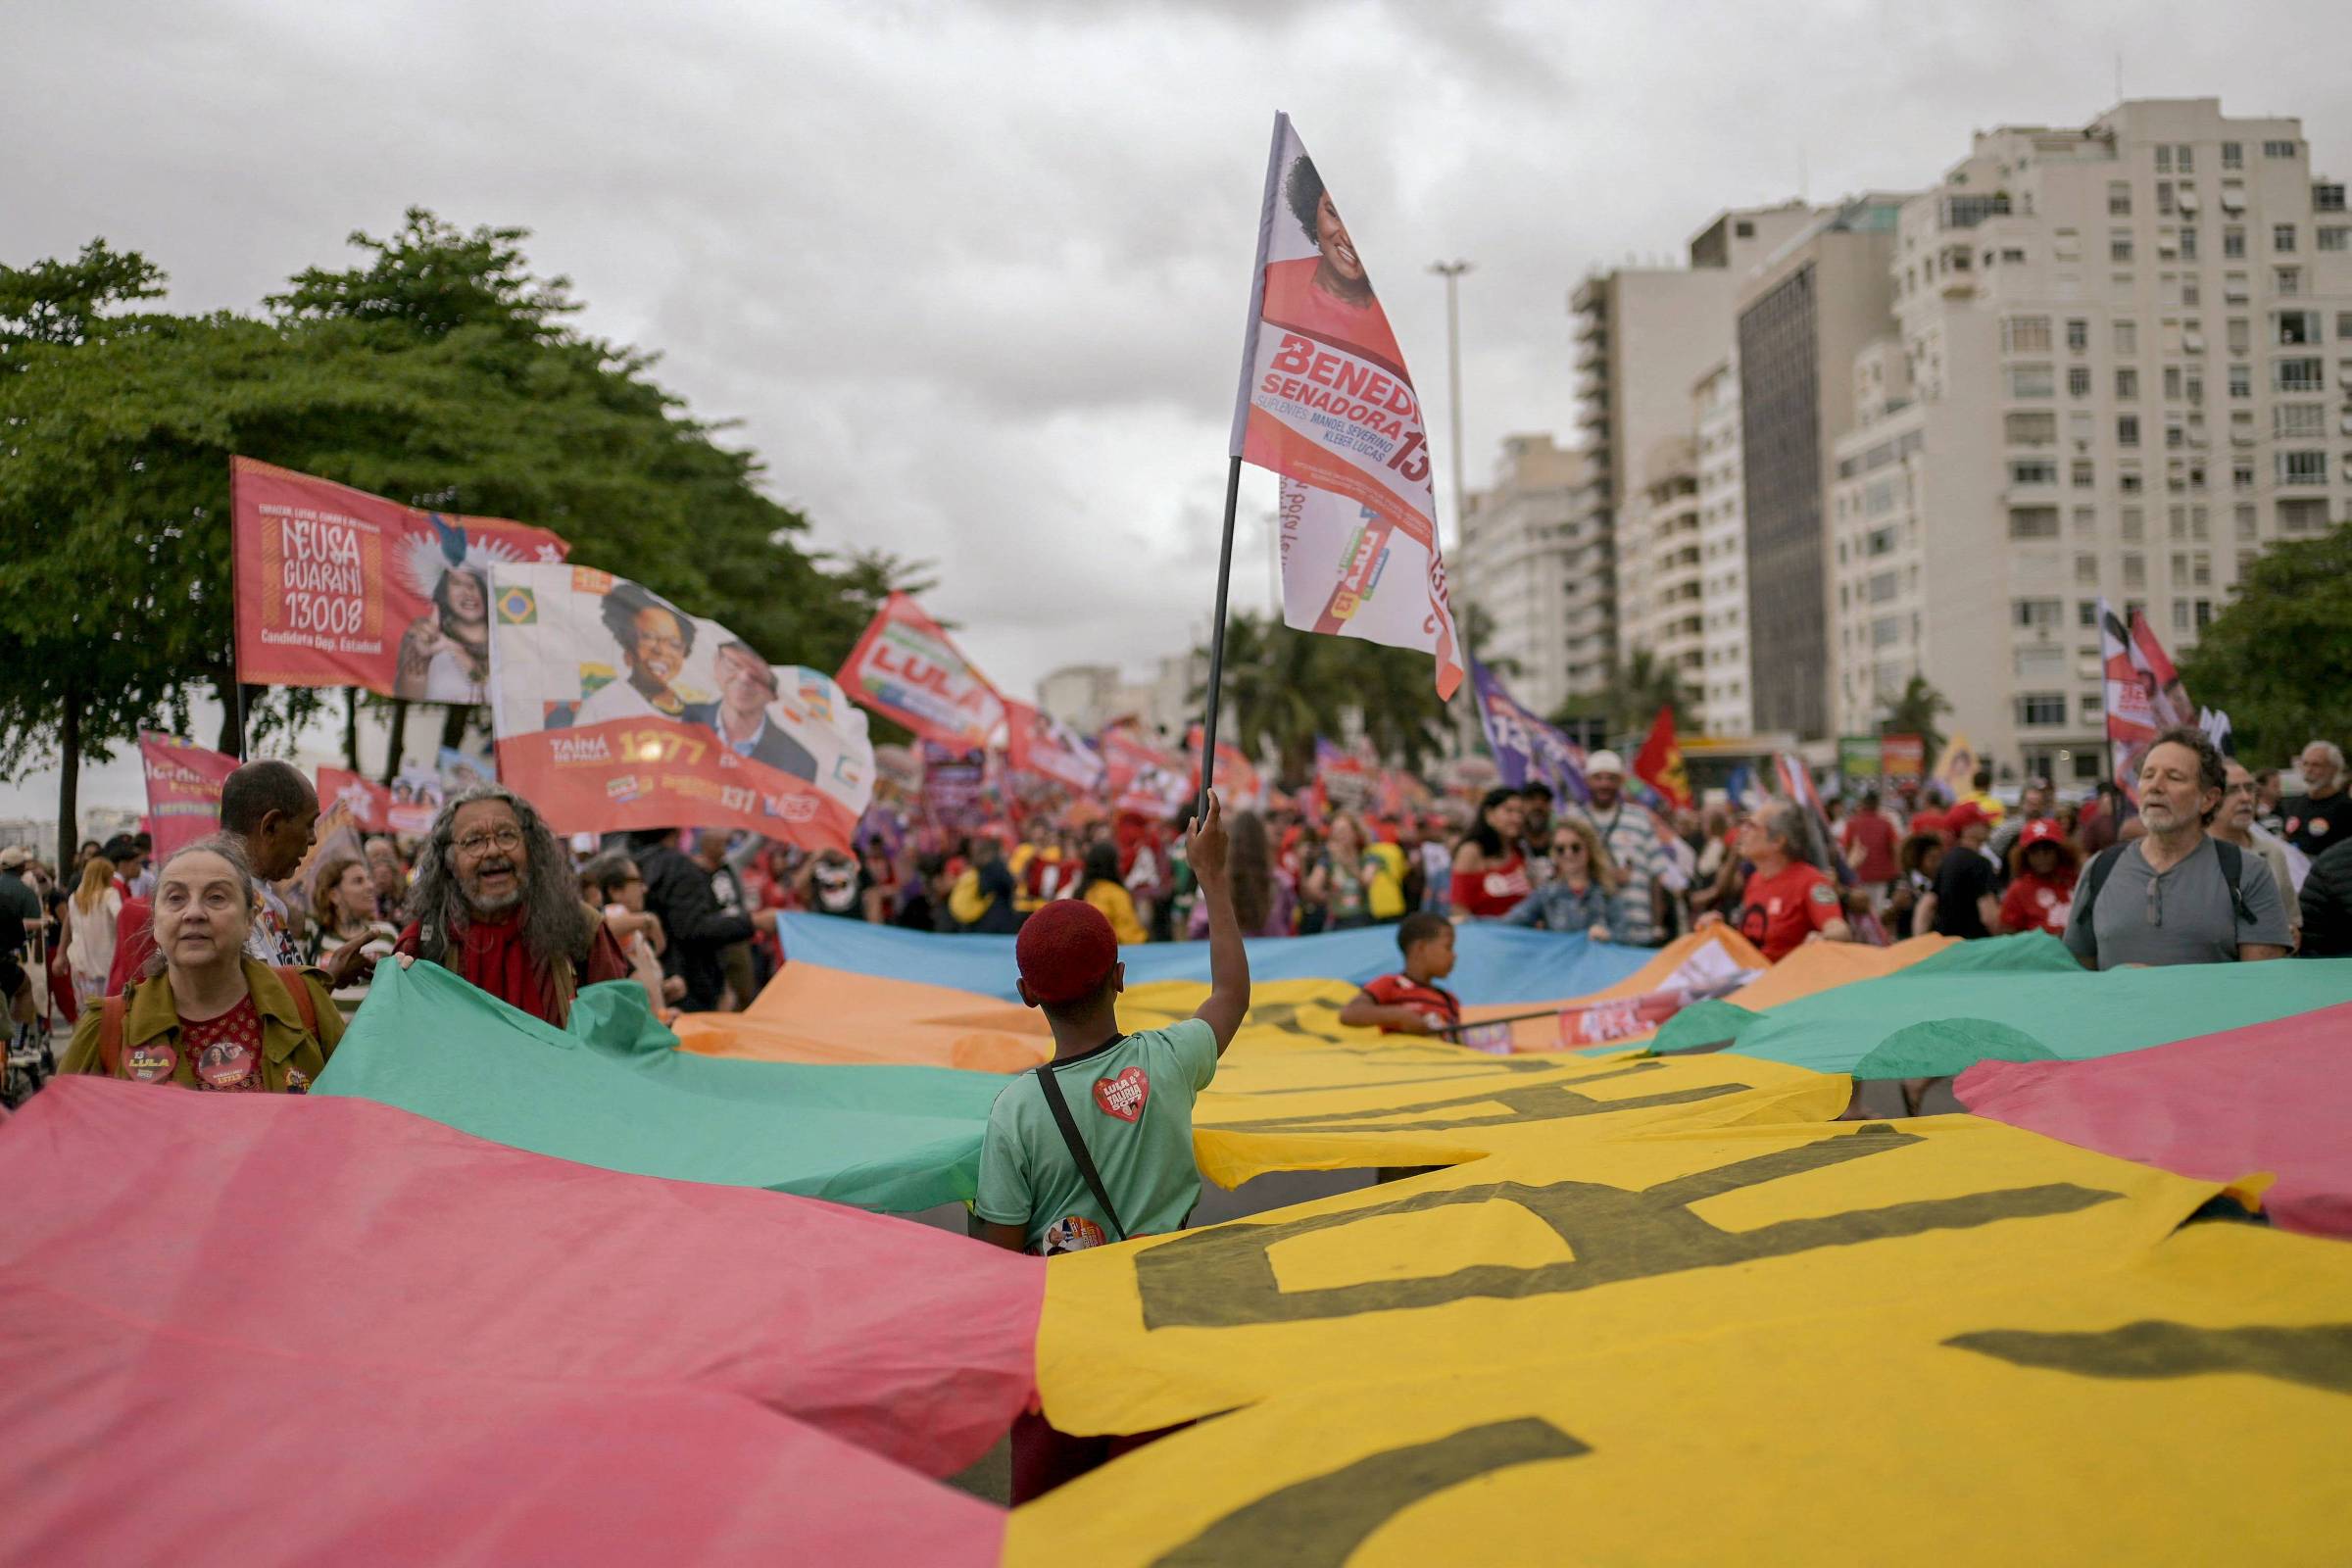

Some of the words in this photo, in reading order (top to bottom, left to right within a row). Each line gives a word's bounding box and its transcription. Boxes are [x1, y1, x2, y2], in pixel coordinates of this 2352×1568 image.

[1260, 373, 1402, 441] SENADORA
[1309, 412, 1346, 433] MANOEL
[1348, 423, 1394, 454] SEVERINO
[1323, 430, 1351, 448] KLEBER
[1351, 441, 1386, 463] LUCAS
[281, 517, 361, 566] NEUSA
[283, 558, 363, 596] GUARANI
[285, 591, 364, 635] 13008
[261, 627, 315, 648] Candidata
[339, 636, 382, 656] Estadual
[871, 642, 986, 715] LULA
[128, 1058, 171, 1067] LULA
[1103, 1079, 1130, 1097] LULA
